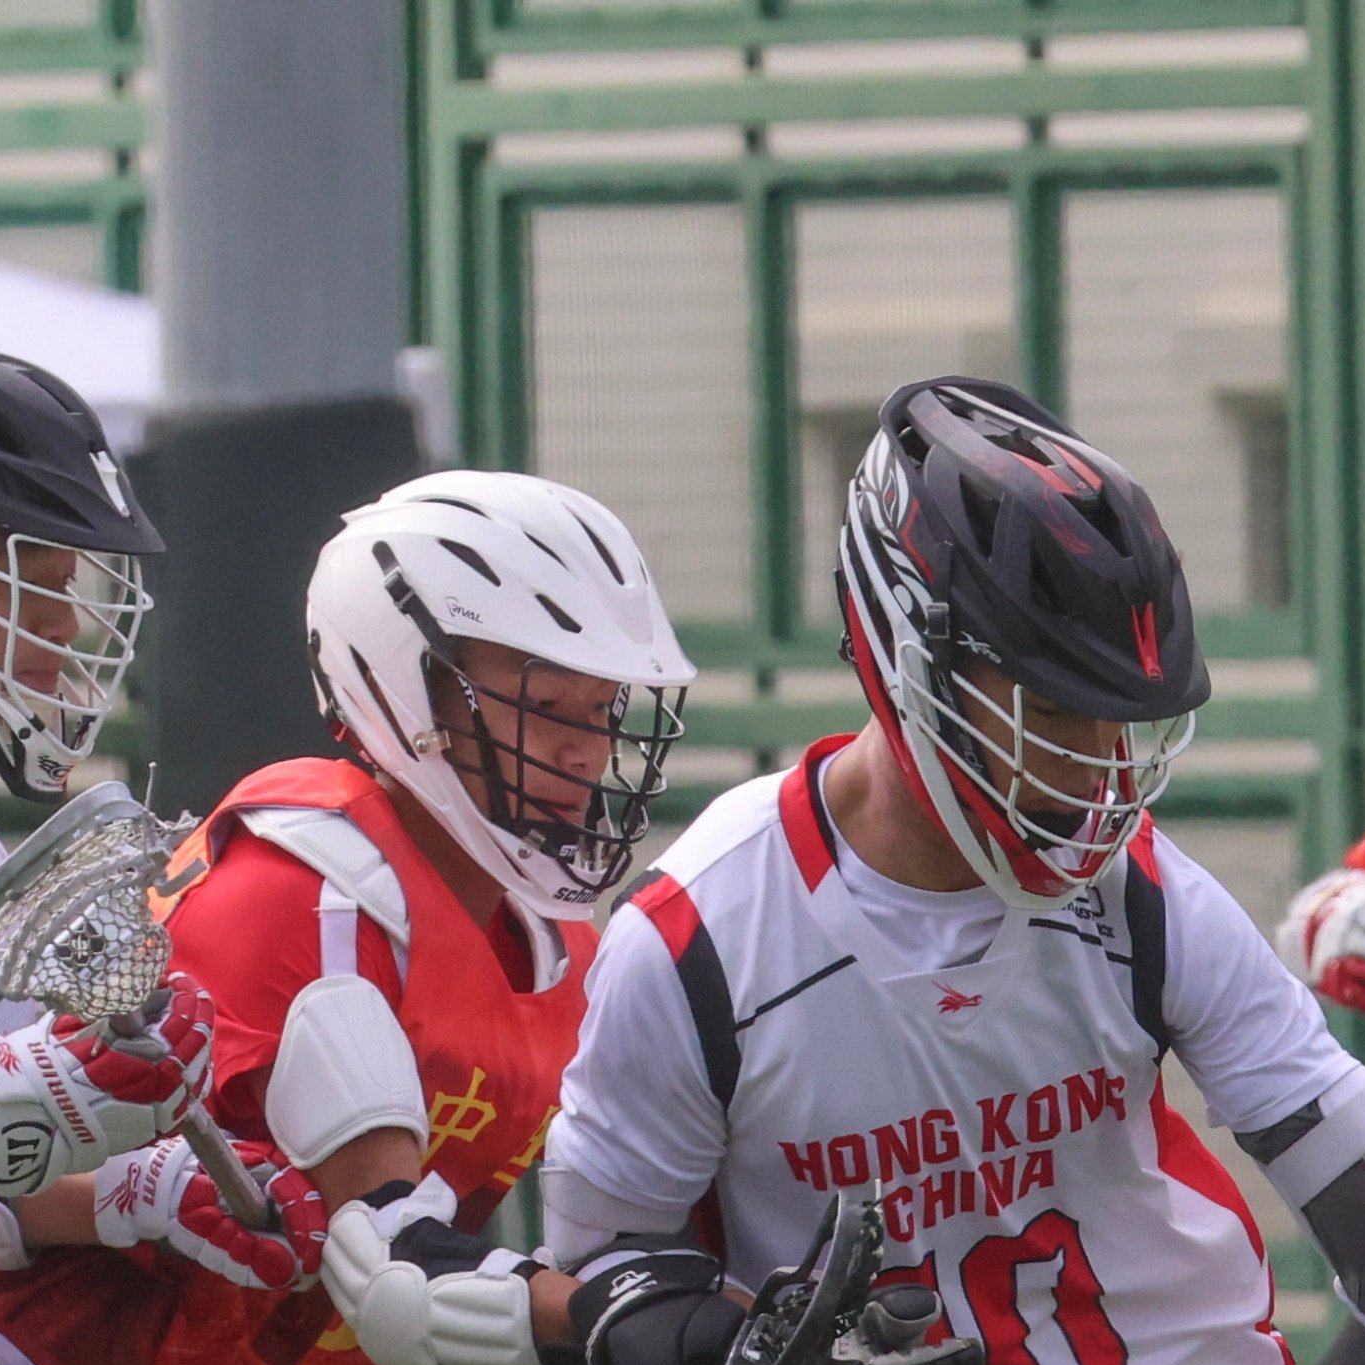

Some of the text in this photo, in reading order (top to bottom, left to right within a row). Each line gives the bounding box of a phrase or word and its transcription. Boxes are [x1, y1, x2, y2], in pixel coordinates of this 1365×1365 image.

[27, 1041, 97, 1144] WARRIOR
[778, 1066, 1128, 1192] HONG KONG
[883, 1149, 1056, 1244] CHINA
